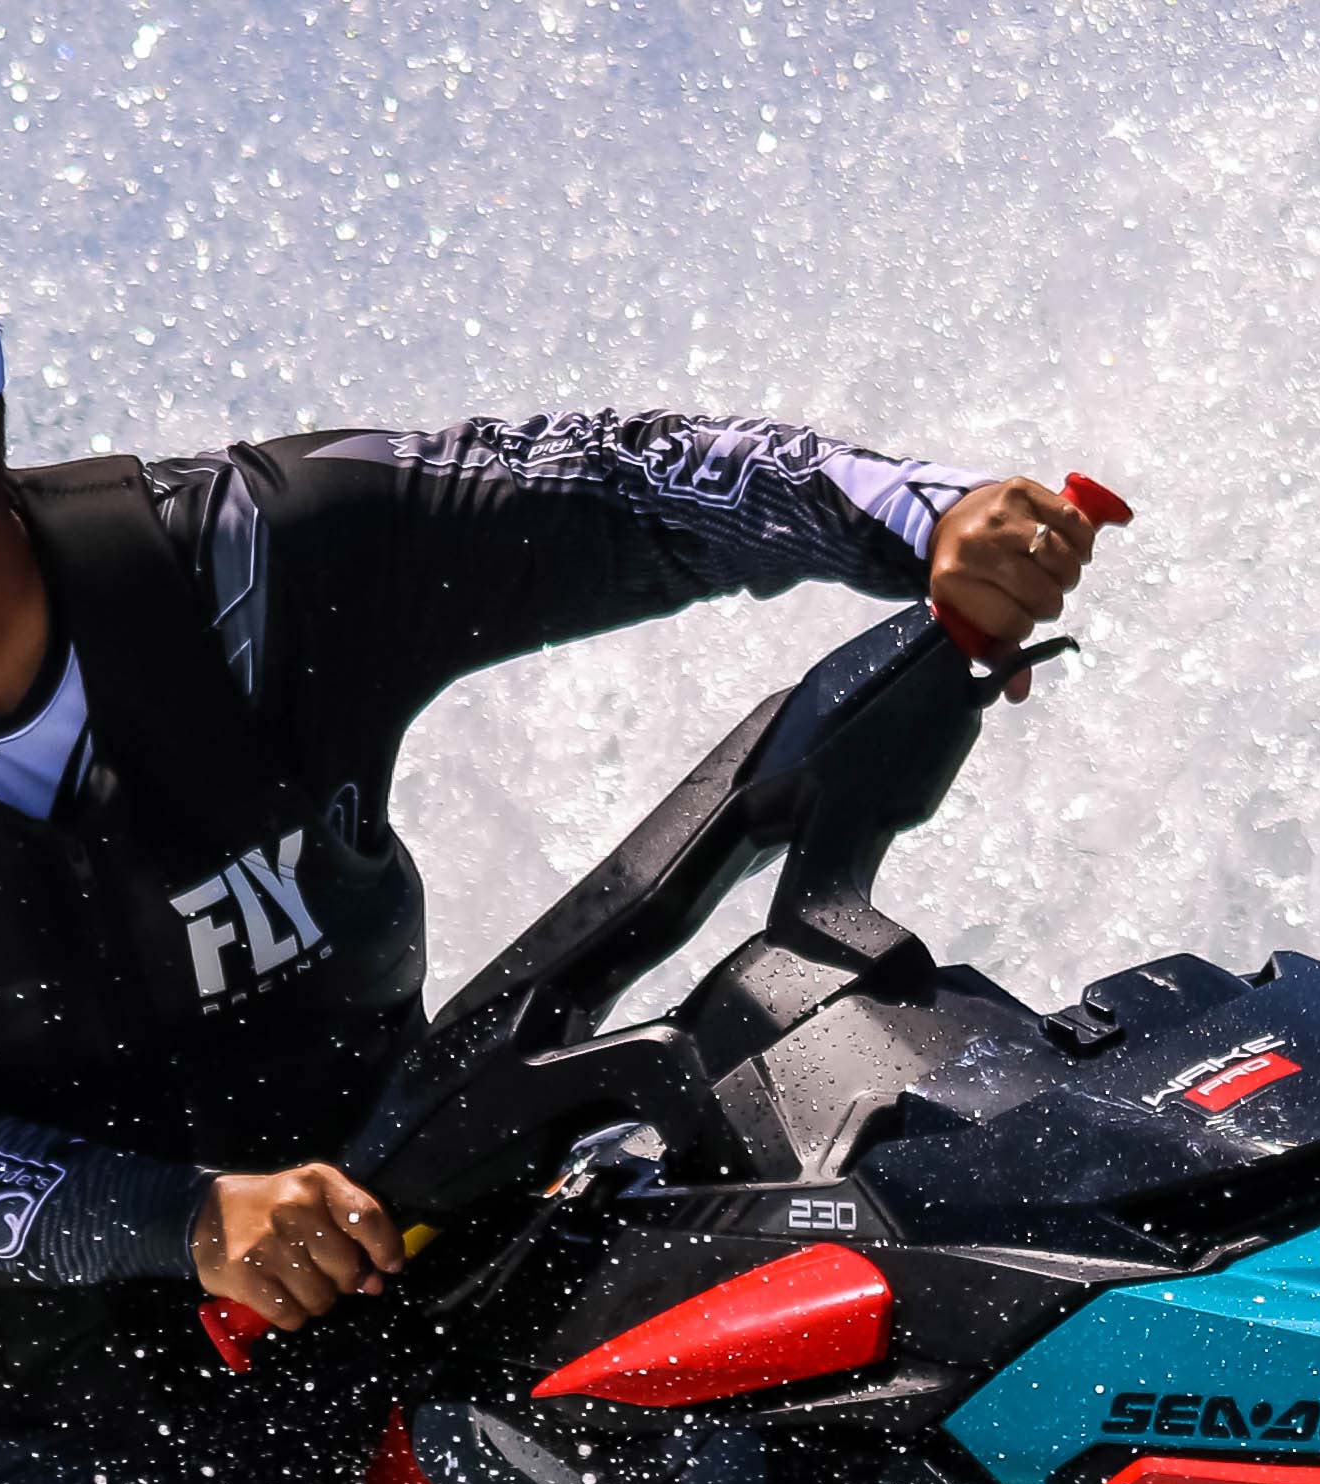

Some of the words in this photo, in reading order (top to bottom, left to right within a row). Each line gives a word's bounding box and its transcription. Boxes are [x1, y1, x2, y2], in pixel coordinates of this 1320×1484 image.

[169, 829, 323, 997] FLY
[1142, 1035, 1285, 1106] WAKE
[1197, 1058, 1271, 1096] PRO
[788, 1199, 857, 1231] 230
